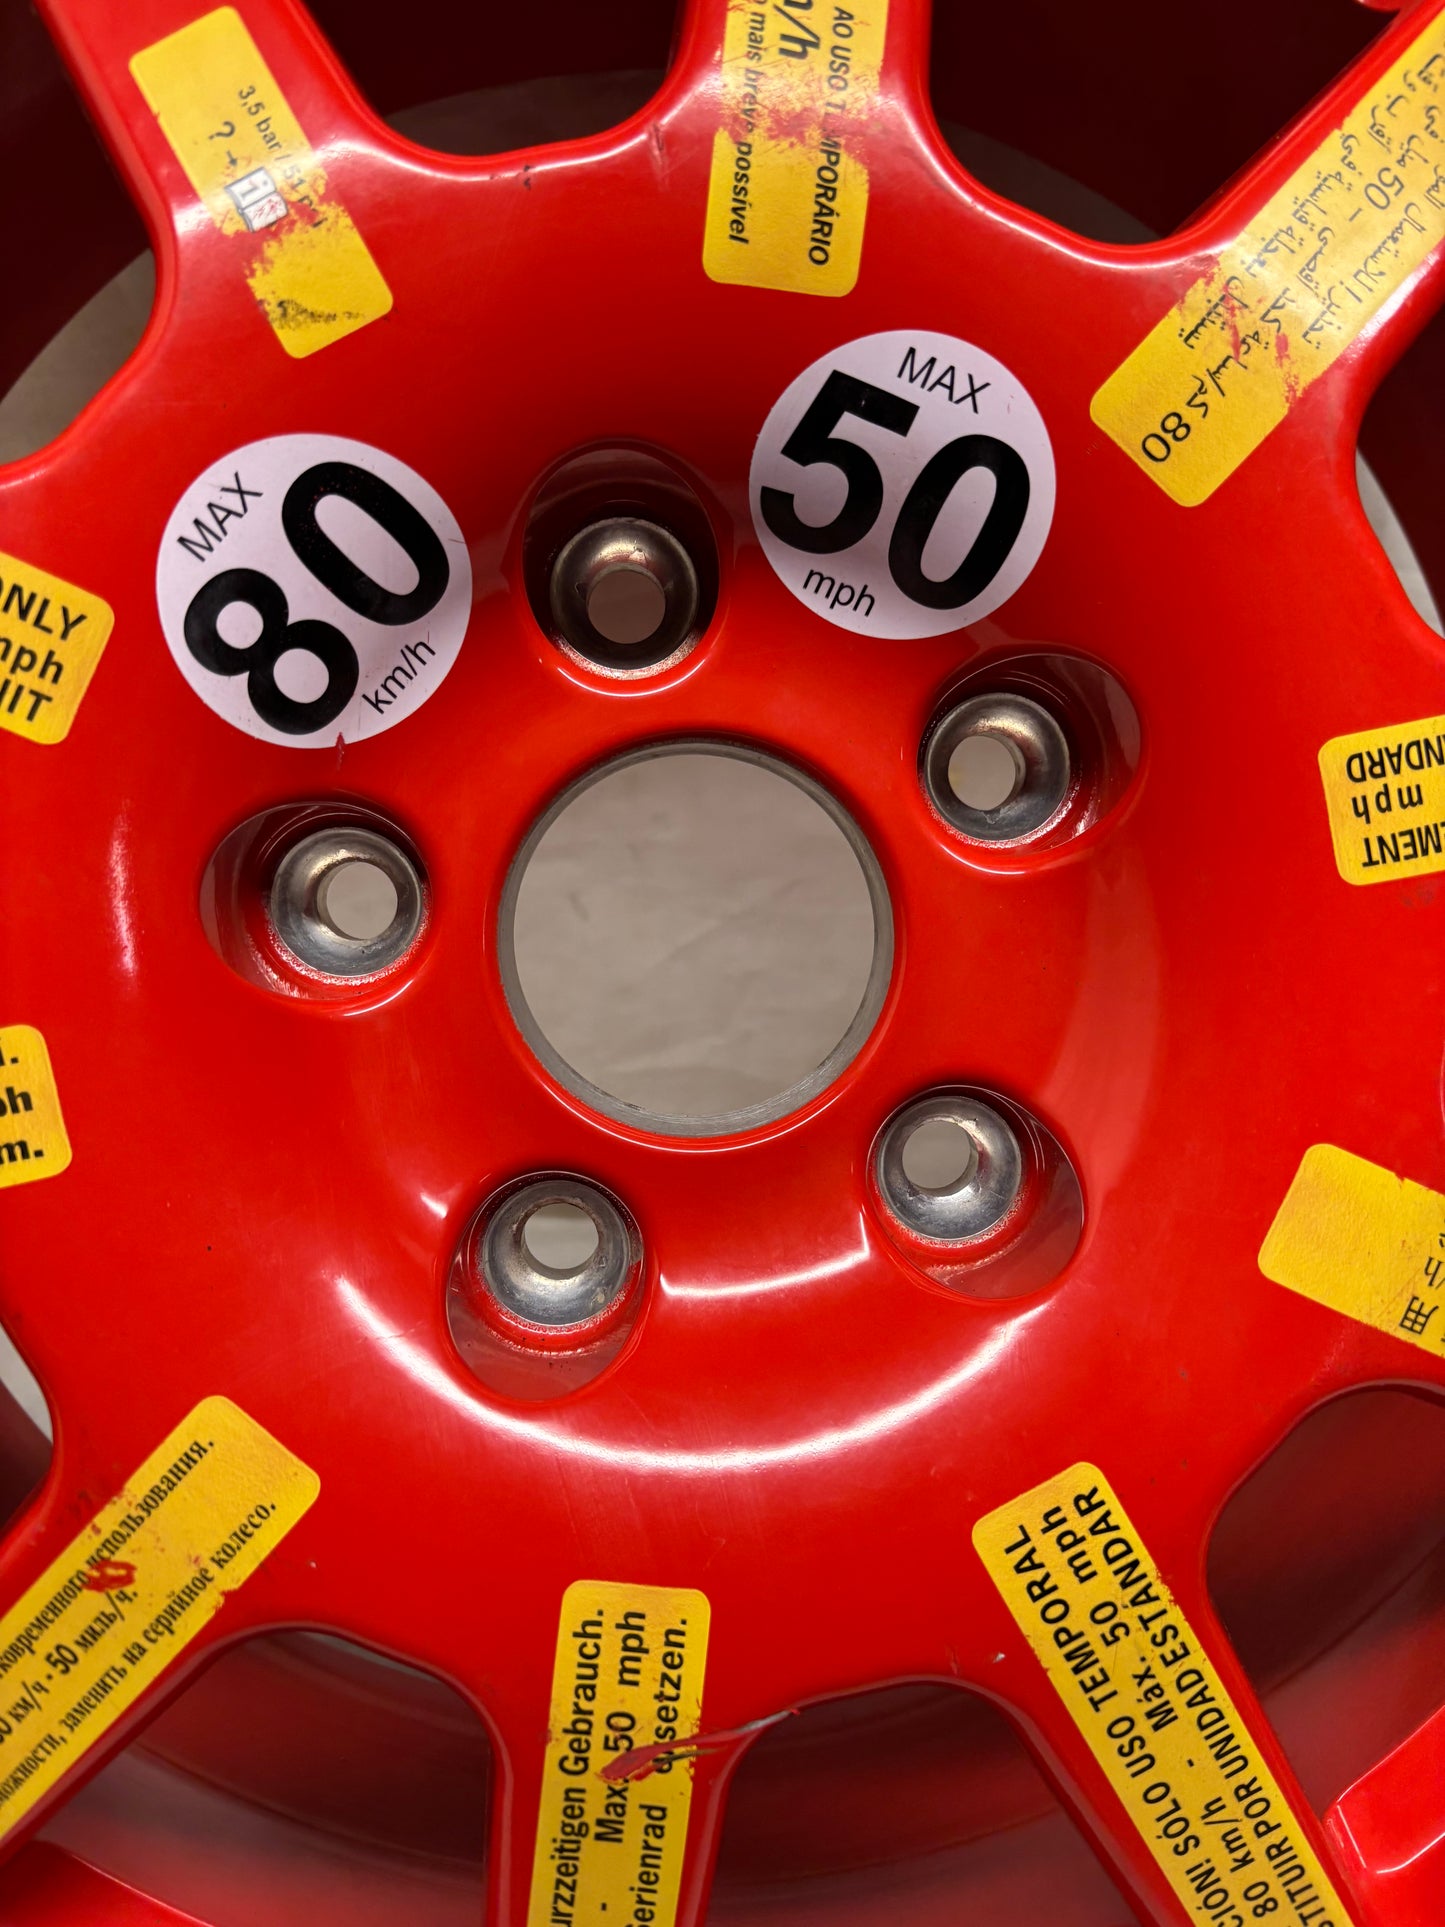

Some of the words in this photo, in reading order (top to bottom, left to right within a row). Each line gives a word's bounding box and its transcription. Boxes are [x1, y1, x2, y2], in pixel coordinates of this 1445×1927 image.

[748, 12, 765, 61] mais
[833, 7, 854, 38] AO
[828, 45, 851, 90] USO
[239, 86, 265, 116] 3,5
[256, 117, 281, 149] bar
[283, 163, 307, 192] 51
[298, 195, 328, 228] pi
[808, 101, 847, 266] TMPORÁRIO
[1340, 134, 1362, 175] في
[729, 142, 752, 244] possível
[1142, 412, 1191, 462] 80
[1364, 167, 1404, 210] 50
[1302, 286, 1341, 350] تحذير
[897, 346, 991, 414] MAX
[177, 472, 263, 562] MAX
[760, 369, 1030, 610] 50
[0, 578, 88, 641] NLY
[184, 461, 450, 736] 80
[803, 569, 876, 617] mph
[0, 679, 53, 722] IT
[362, 641, 436, 715] km/h
[1346, 735, 1445, 783] NDARD
[1352, 784, 1424, 824] mph
[1362, 823, 1445, 868] MENT
[86, 1441, 213, 1571] использования.
[1041, 1506, 1097, 1584] mph
[1074, 1487, 1190, 1667] ESTÁNDAR
[60, 1666, 127, 1732] заменить
[123, 1643, 147, 1665] на
[143, 1568, 214, 1644] серийное
[210, 1504, 276, 1569] колесо.
[615, 1612, 649, 1686] mph
[1005, 1525, 1118, 1712] TEMPORAL
[1090, 1601, 1130, 1647] 50
[7, 1681, 49, 1723] км/ч
[45, 1644, 78, 1674] 50
[74, 1590, 137, 1652] миль/ч.
[558, 1610, 603, 1776] Gebrauch.
[1132, 1656, 1178, 1732] Máx.
[1176, 1669, 1248, 1779] UNIDAD
[603, 1712, 636, 1754] 50
[1107, 1716, 1155, 1778] USO
[594, 1778, 629, 1843] Max.
[1143, 1782, 1200, 1856] SÓLO
[1201, 1797, 1254, 1873] km/h
[1234, 1777, 1281, 1838] POR
[1243, 1882, 1278, 1918] 80
